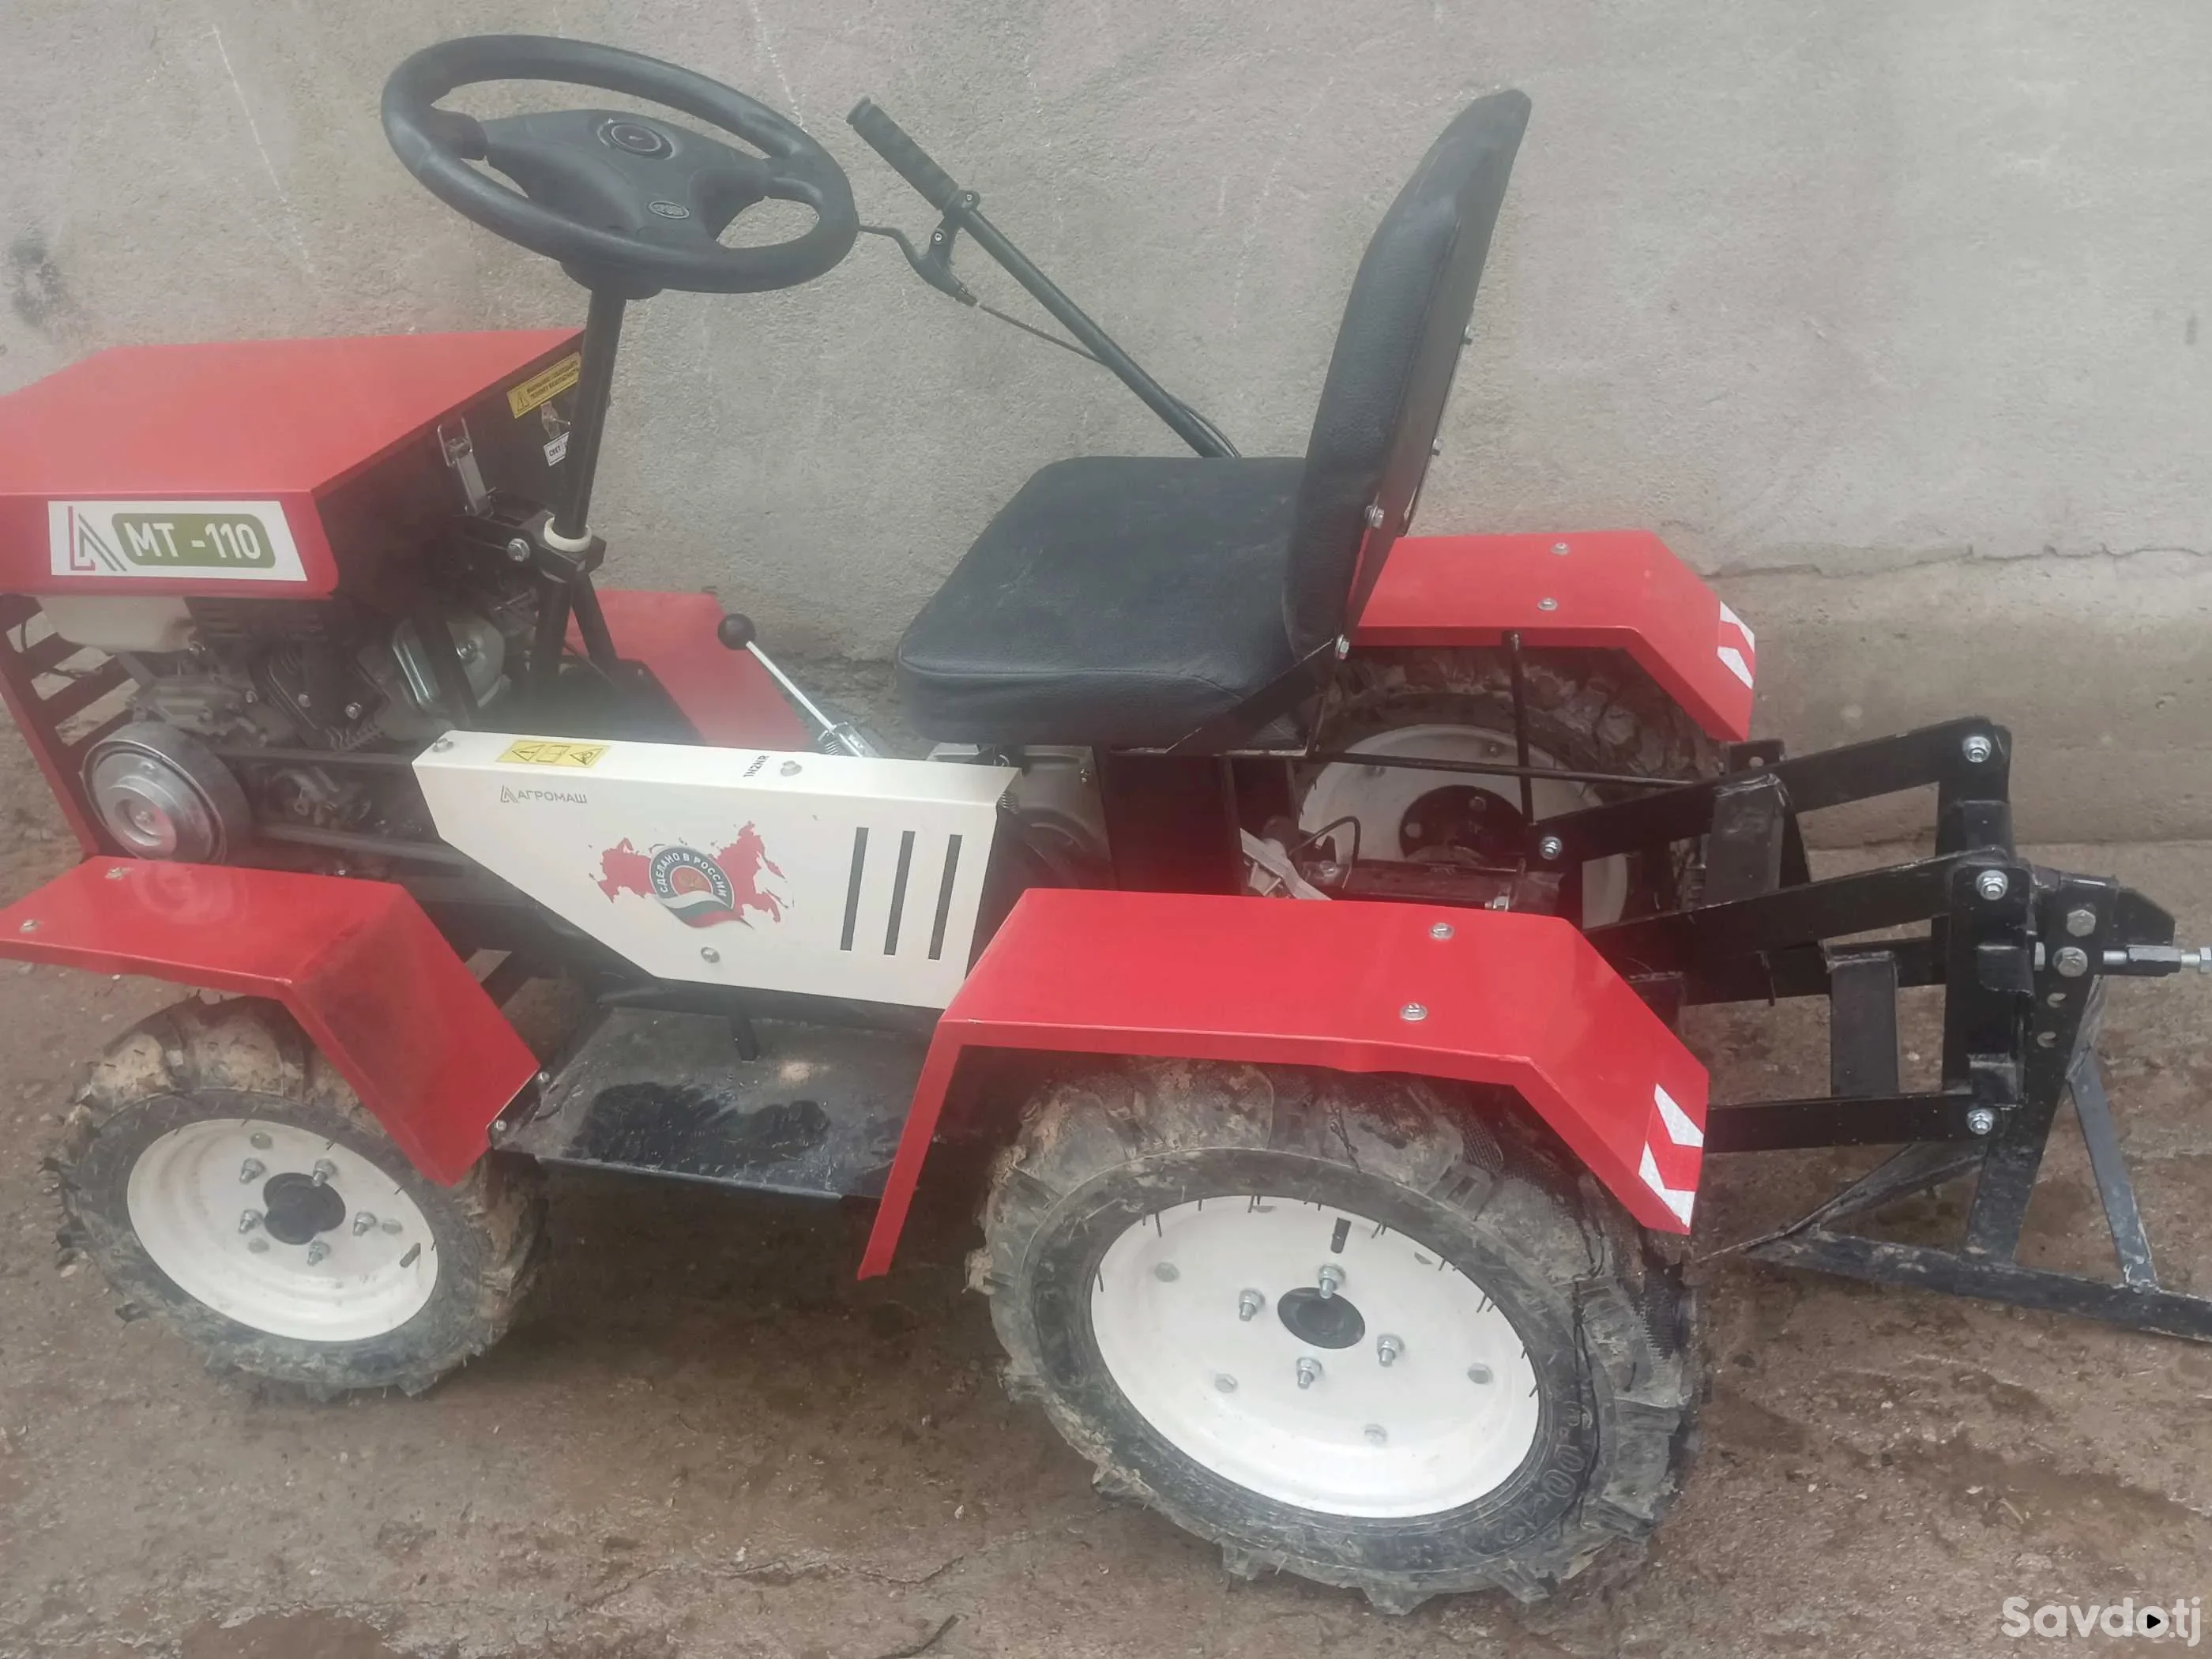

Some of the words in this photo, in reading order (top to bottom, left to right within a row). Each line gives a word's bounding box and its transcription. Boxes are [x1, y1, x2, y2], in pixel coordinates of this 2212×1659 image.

[191, 522, 261, 559] -110
[517, 789, 588, 804] АГРОМАШ
[655, 852, 680, 893] СДЕЛАНО
[682, 852, 690, 862] В
[693, 856, 728, 897] РОССИИ
